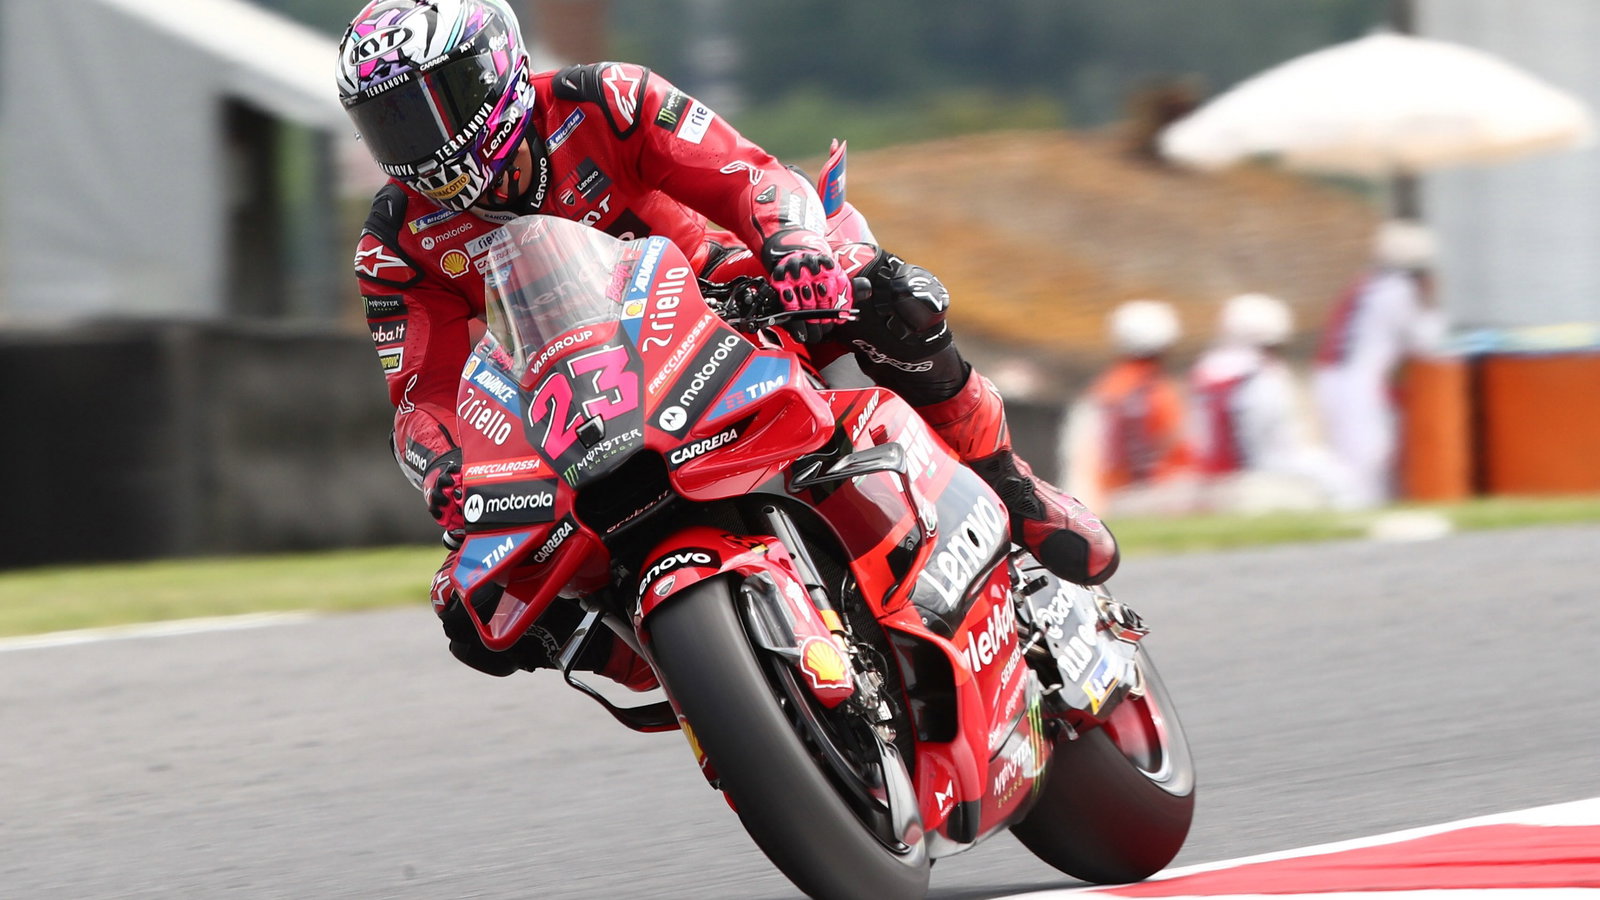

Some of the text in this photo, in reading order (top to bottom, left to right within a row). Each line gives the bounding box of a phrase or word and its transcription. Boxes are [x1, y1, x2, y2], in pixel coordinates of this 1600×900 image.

[354, 28, 401, 60] KYT
[420, 54, 450, 71] CARRERA
[365, 73, 410, 98] TERRANOVA
[435, 102, 493, 161] TERRANOVA
[483, 106, 520, 159] Lenovo
[692, 107, 707, 126] rie
[531, 157, 548, 208] Lenovo
[577, 170, 599, 191] Lenovo
[436, 222, 473, 244] motorola
[650, 266, 690, 331] riello
[531, 331, 593, 374] VARGROUP
[649, 314, 712, 395] FRECCIAROSSA
[680, 335, 740, 406] motorola
[474, 370, 516, 403] ADVANCE
[528, 345, 639, 461] 23
[746, 375, 785, 399] TIM
[463, 400, 512, 446] riello
[576, 428, 642, 471] MONSTER
[670, 428, 738, 465] CARRERA
[465, 459, 541, 476] FRECCIAROSSA
[486, 491, 553, 513] motorola
[482, 536, 515, 569] TIM
[533, 522, 573, 563] CARRERA
[919, 495, 1002, 608] Lenovo
